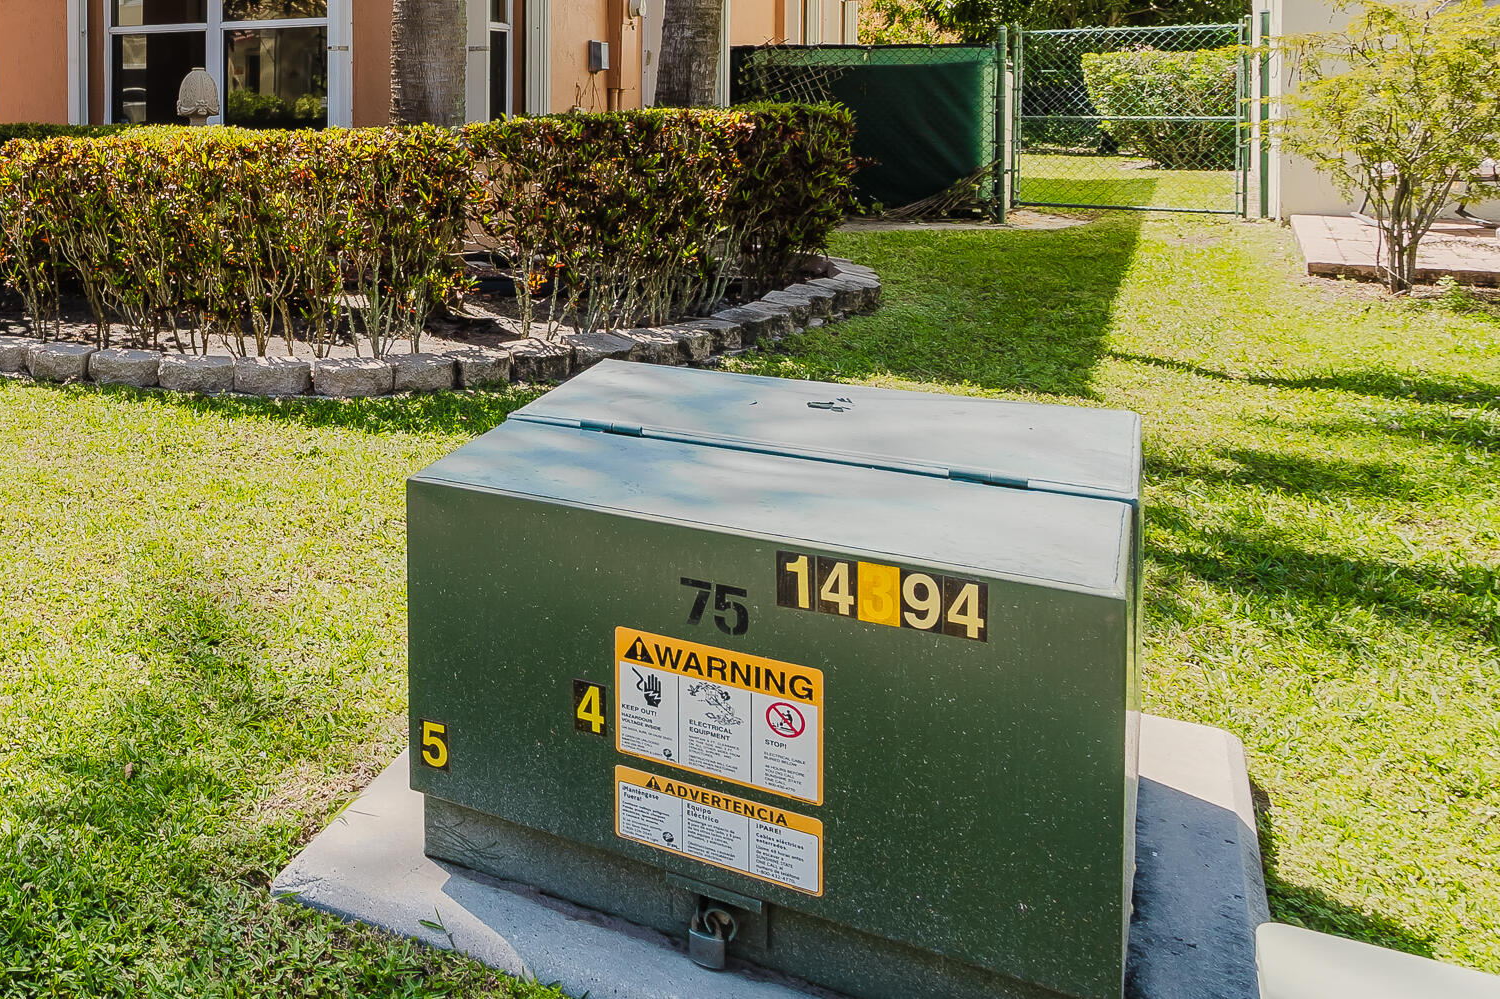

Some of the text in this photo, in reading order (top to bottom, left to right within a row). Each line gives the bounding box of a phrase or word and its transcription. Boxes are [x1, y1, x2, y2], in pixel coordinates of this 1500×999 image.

[785, 554, 985, 640] 14394
[680, 576, 749, 636] 75
[654, 643, 814, 701] WARNING
[576, 685, 605, 734] 4
[622, 703, 656, 717] KEEP OUT!
[621, 712, 652, 723] HAZARDOUS
[621, 717, 643, 726] VOLTAGE
[689, 719, 732, 735] ELECTRICAL
[689, 726, 730, 742] EQUIPMENT
[421, 720, 449, 768] 5
[765, 738, 787, 750] STOP!
[623, 792, 642, 802] Fuera!
[664, 782, 789, 827] ADVERTENCIA
[686, 803, 711, 816] Equipo
[686, 809, 718, 824] Eléctrico
[756, 823, 781, 835] ¡PARE!
[756, 832, 774, 842] Cables
